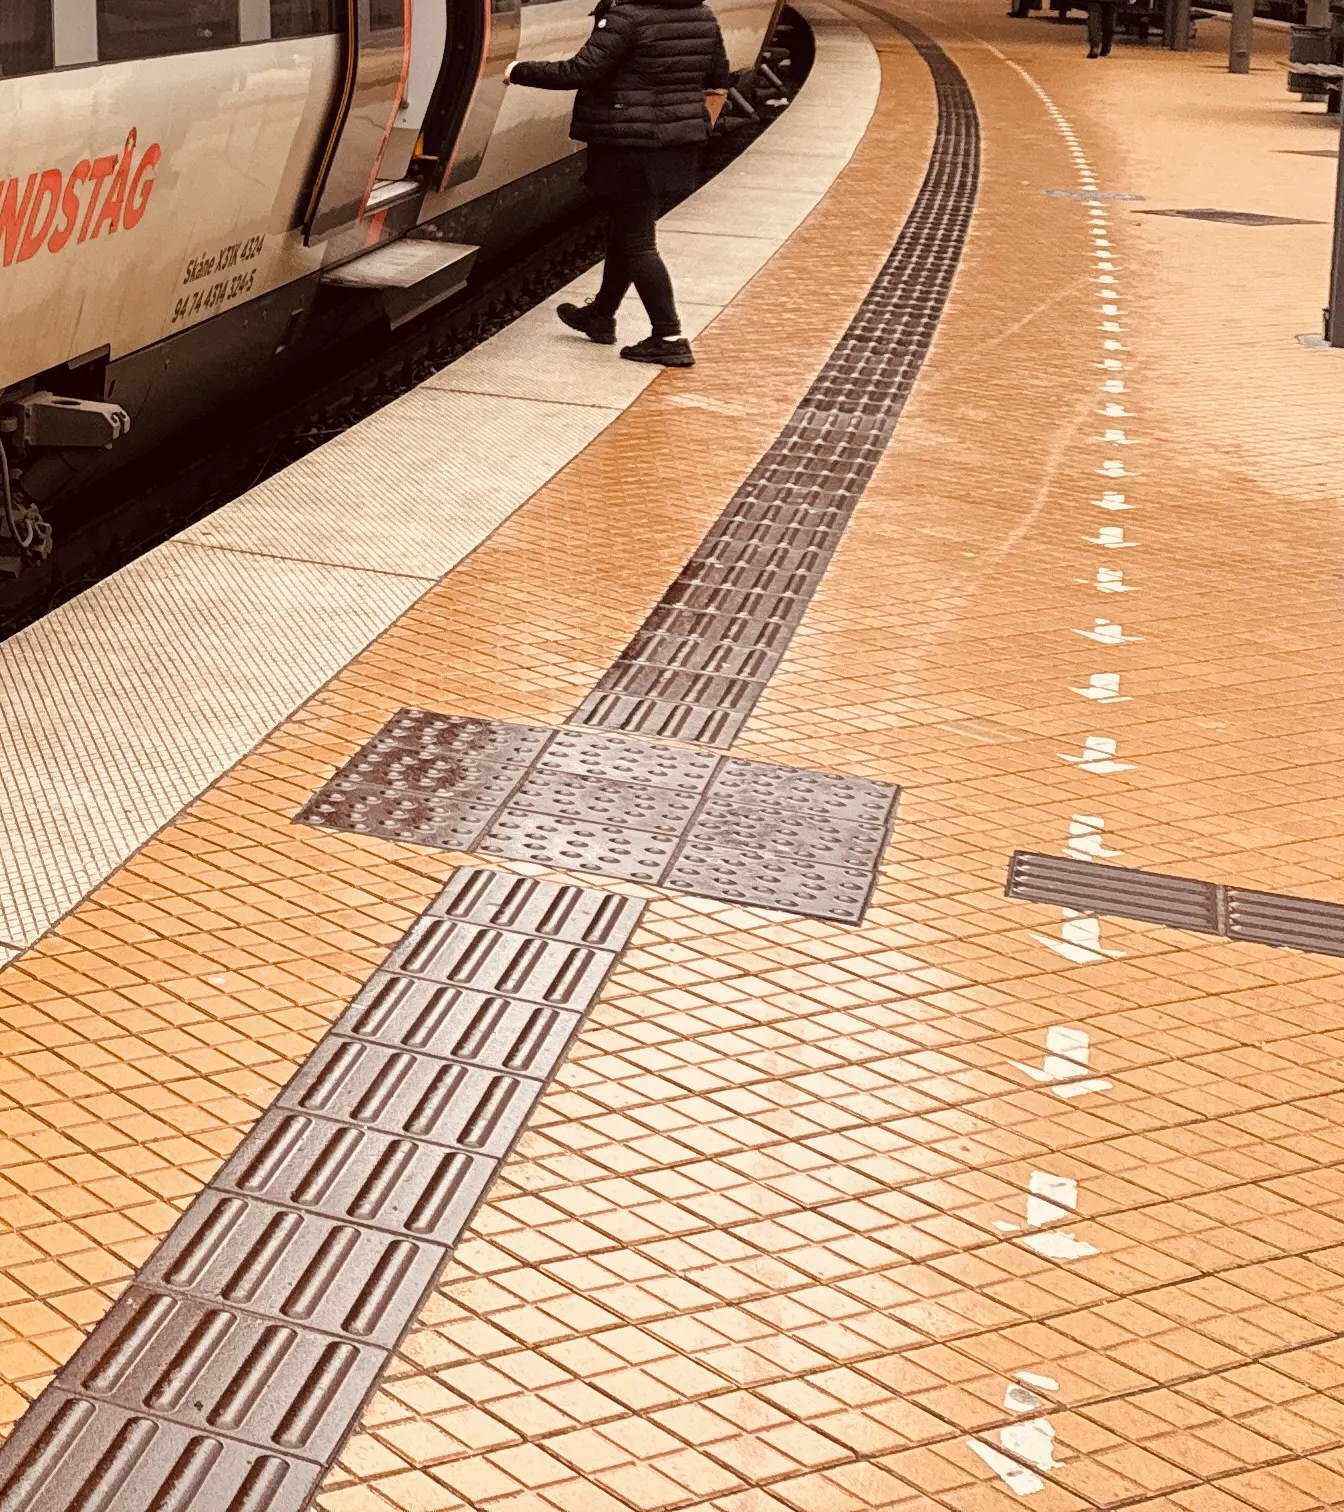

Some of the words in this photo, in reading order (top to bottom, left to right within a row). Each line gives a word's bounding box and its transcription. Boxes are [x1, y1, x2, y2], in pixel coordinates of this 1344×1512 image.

[182, 251, 216, 285] Skåne
[240, 234, 266, 262] 4324
[172, 295, 190, 323] 94
[188, 289, 205, 317] 74
